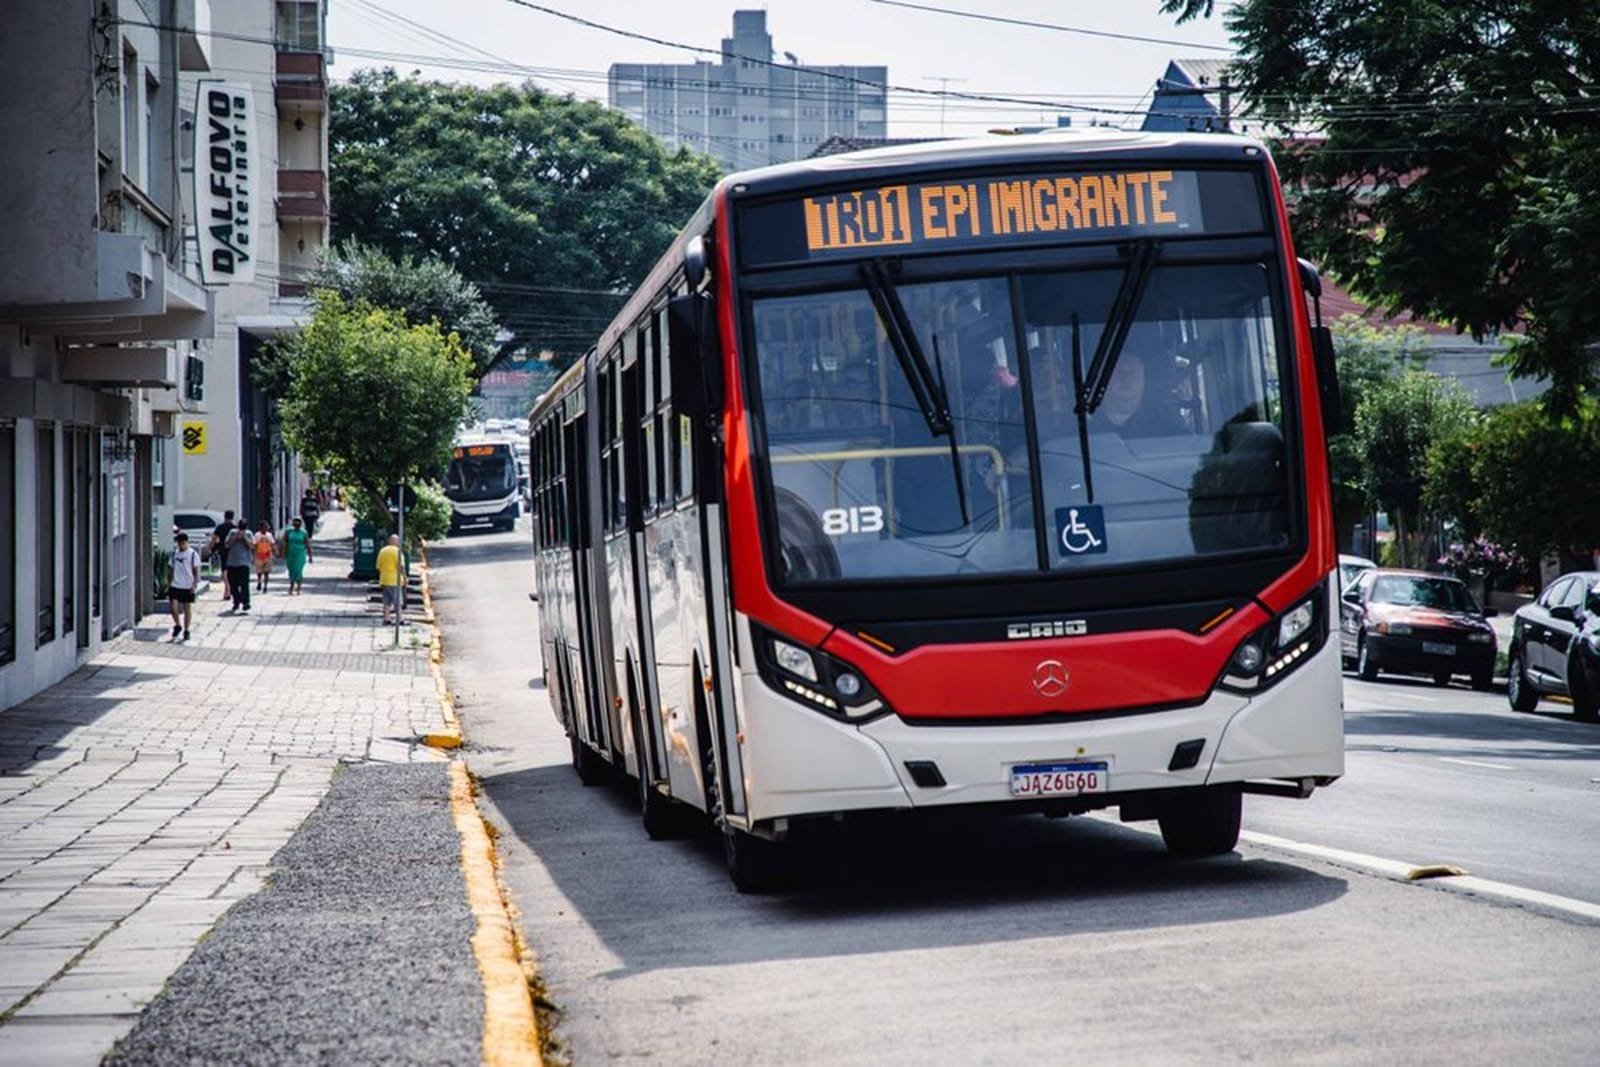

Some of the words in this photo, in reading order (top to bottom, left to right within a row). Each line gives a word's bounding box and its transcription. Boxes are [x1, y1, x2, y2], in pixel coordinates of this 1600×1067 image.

[208, 90, 235, 274] DALFOVO
[921, 184, 981, 239] EPI
[989, 171, 1177, 234] IMIGRANTE
[822, 506, 884, 535] 813
[1007, 620, 1087, 638] CAIO
[1020, 773, 1097, 792] JAZ6G60
